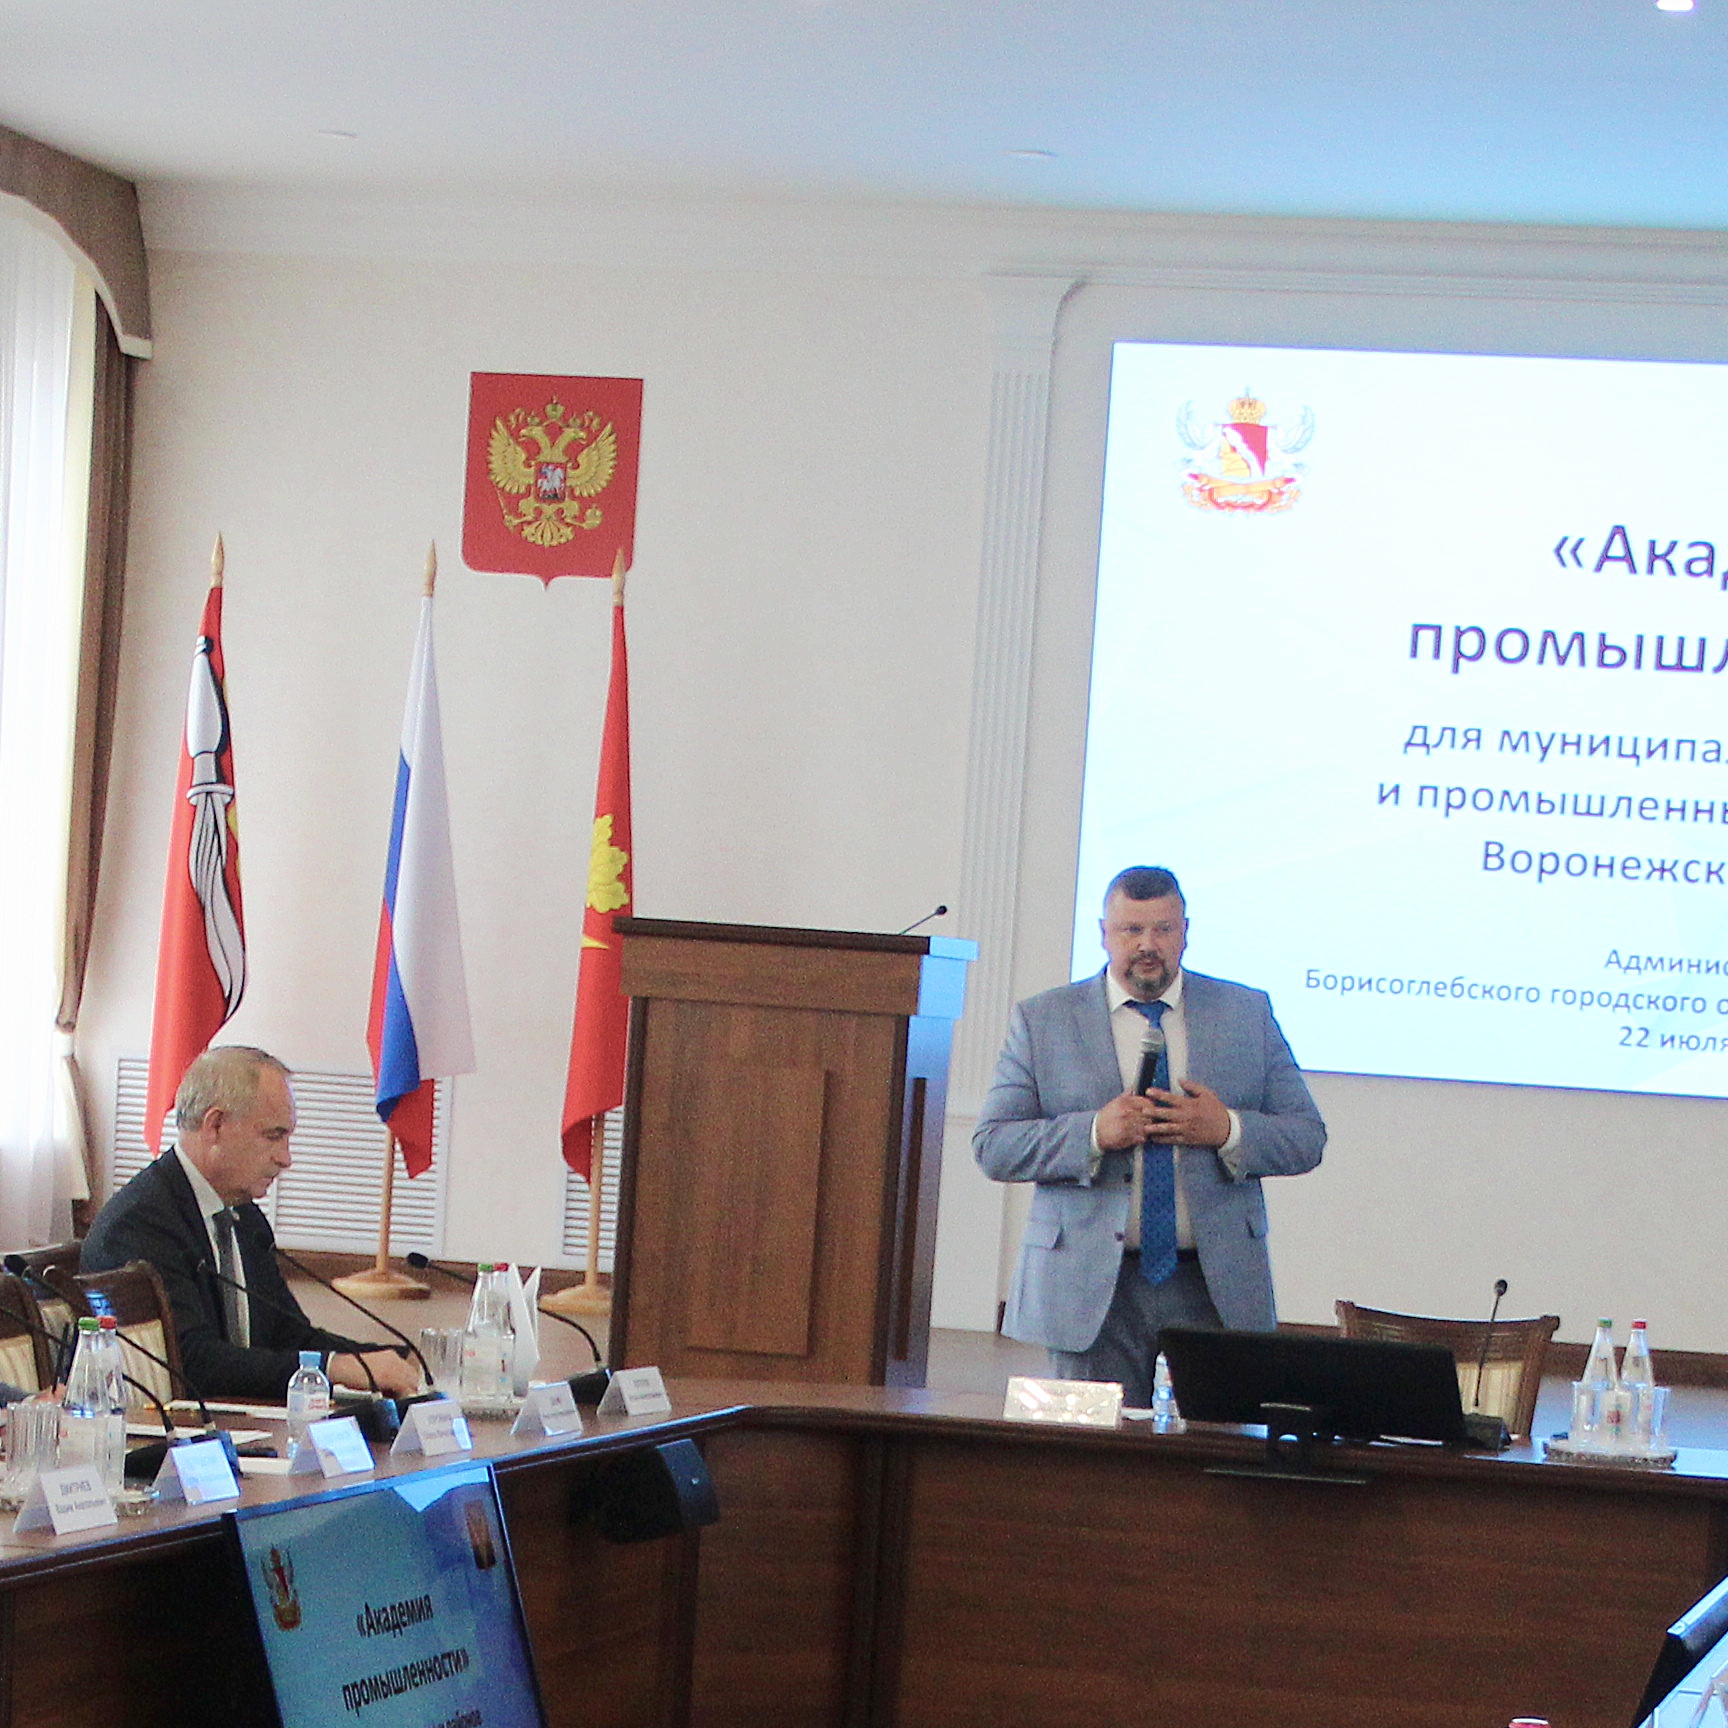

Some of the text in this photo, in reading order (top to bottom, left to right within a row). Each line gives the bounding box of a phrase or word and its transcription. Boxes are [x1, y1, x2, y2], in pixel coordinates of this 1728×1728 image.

[1403, 724, 1482, 756] для
[1377, 782, 1401, 806] и
[1305, 968, 1541, 1003] Борисоглебского
[1549, 986, 1707, 1015] городского
[1618, 1025, 1651, 1049] 22
[356, 1594, 434, 1638] «Академия
[342, 1648, 470, 1717] промышленности»
